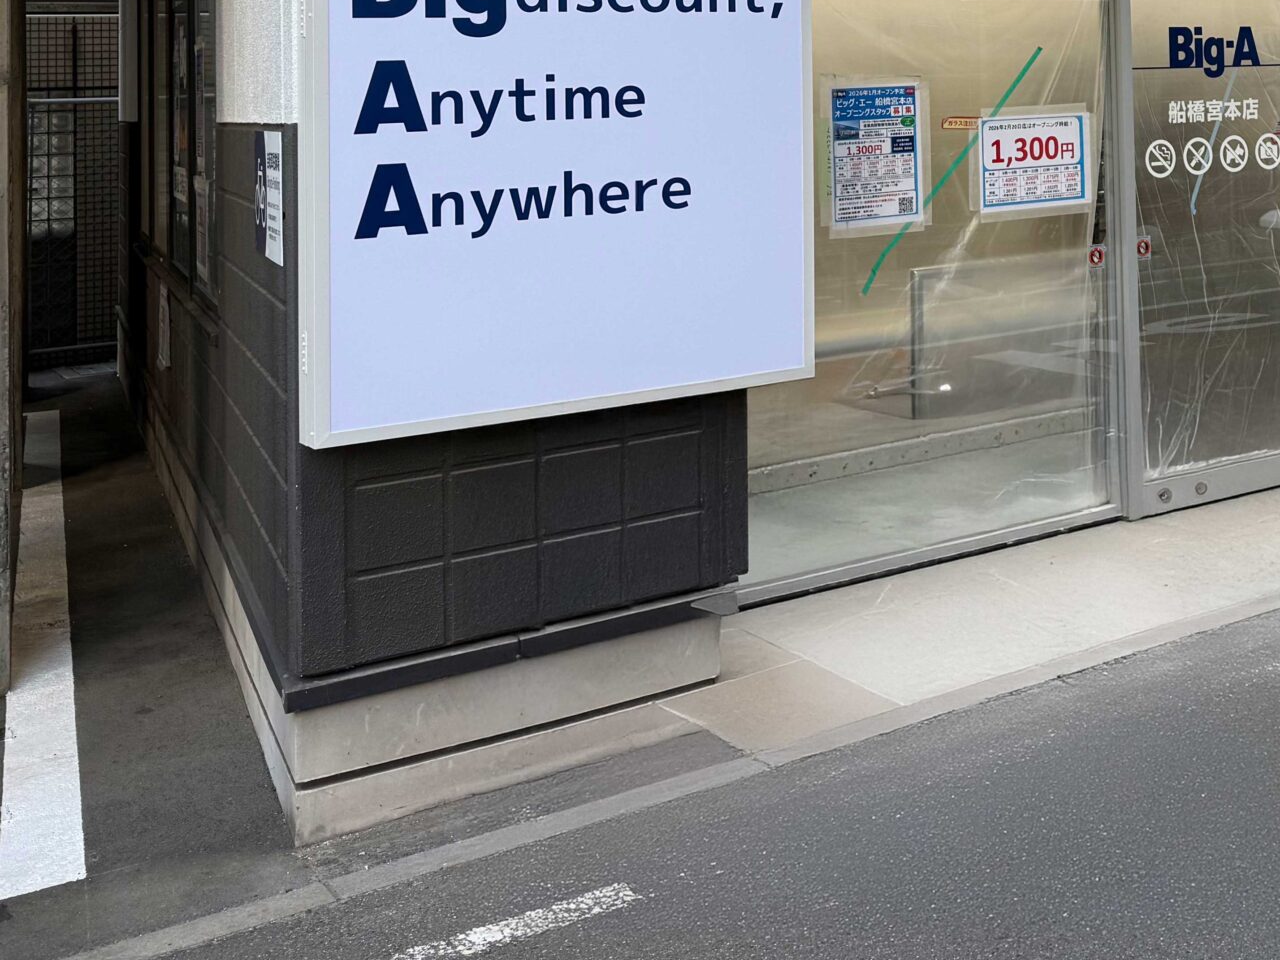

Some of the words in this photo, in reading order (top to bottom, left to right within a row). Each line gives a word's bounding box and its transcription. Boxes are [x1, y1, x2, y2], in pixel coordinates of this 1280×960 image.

[1168, 26, 1260, 78] Big-A
[353, 60, 646, 138] Anytime
[875, 97, 913, 106] 船橋宮本店
[1168, 98, 1259, 124] 船橋宮本店
[846, 145, 882, 156] 1,300円
[991, 135, 1075, 167] 1,300円
[354, 162, 692, 239] Anywhere
